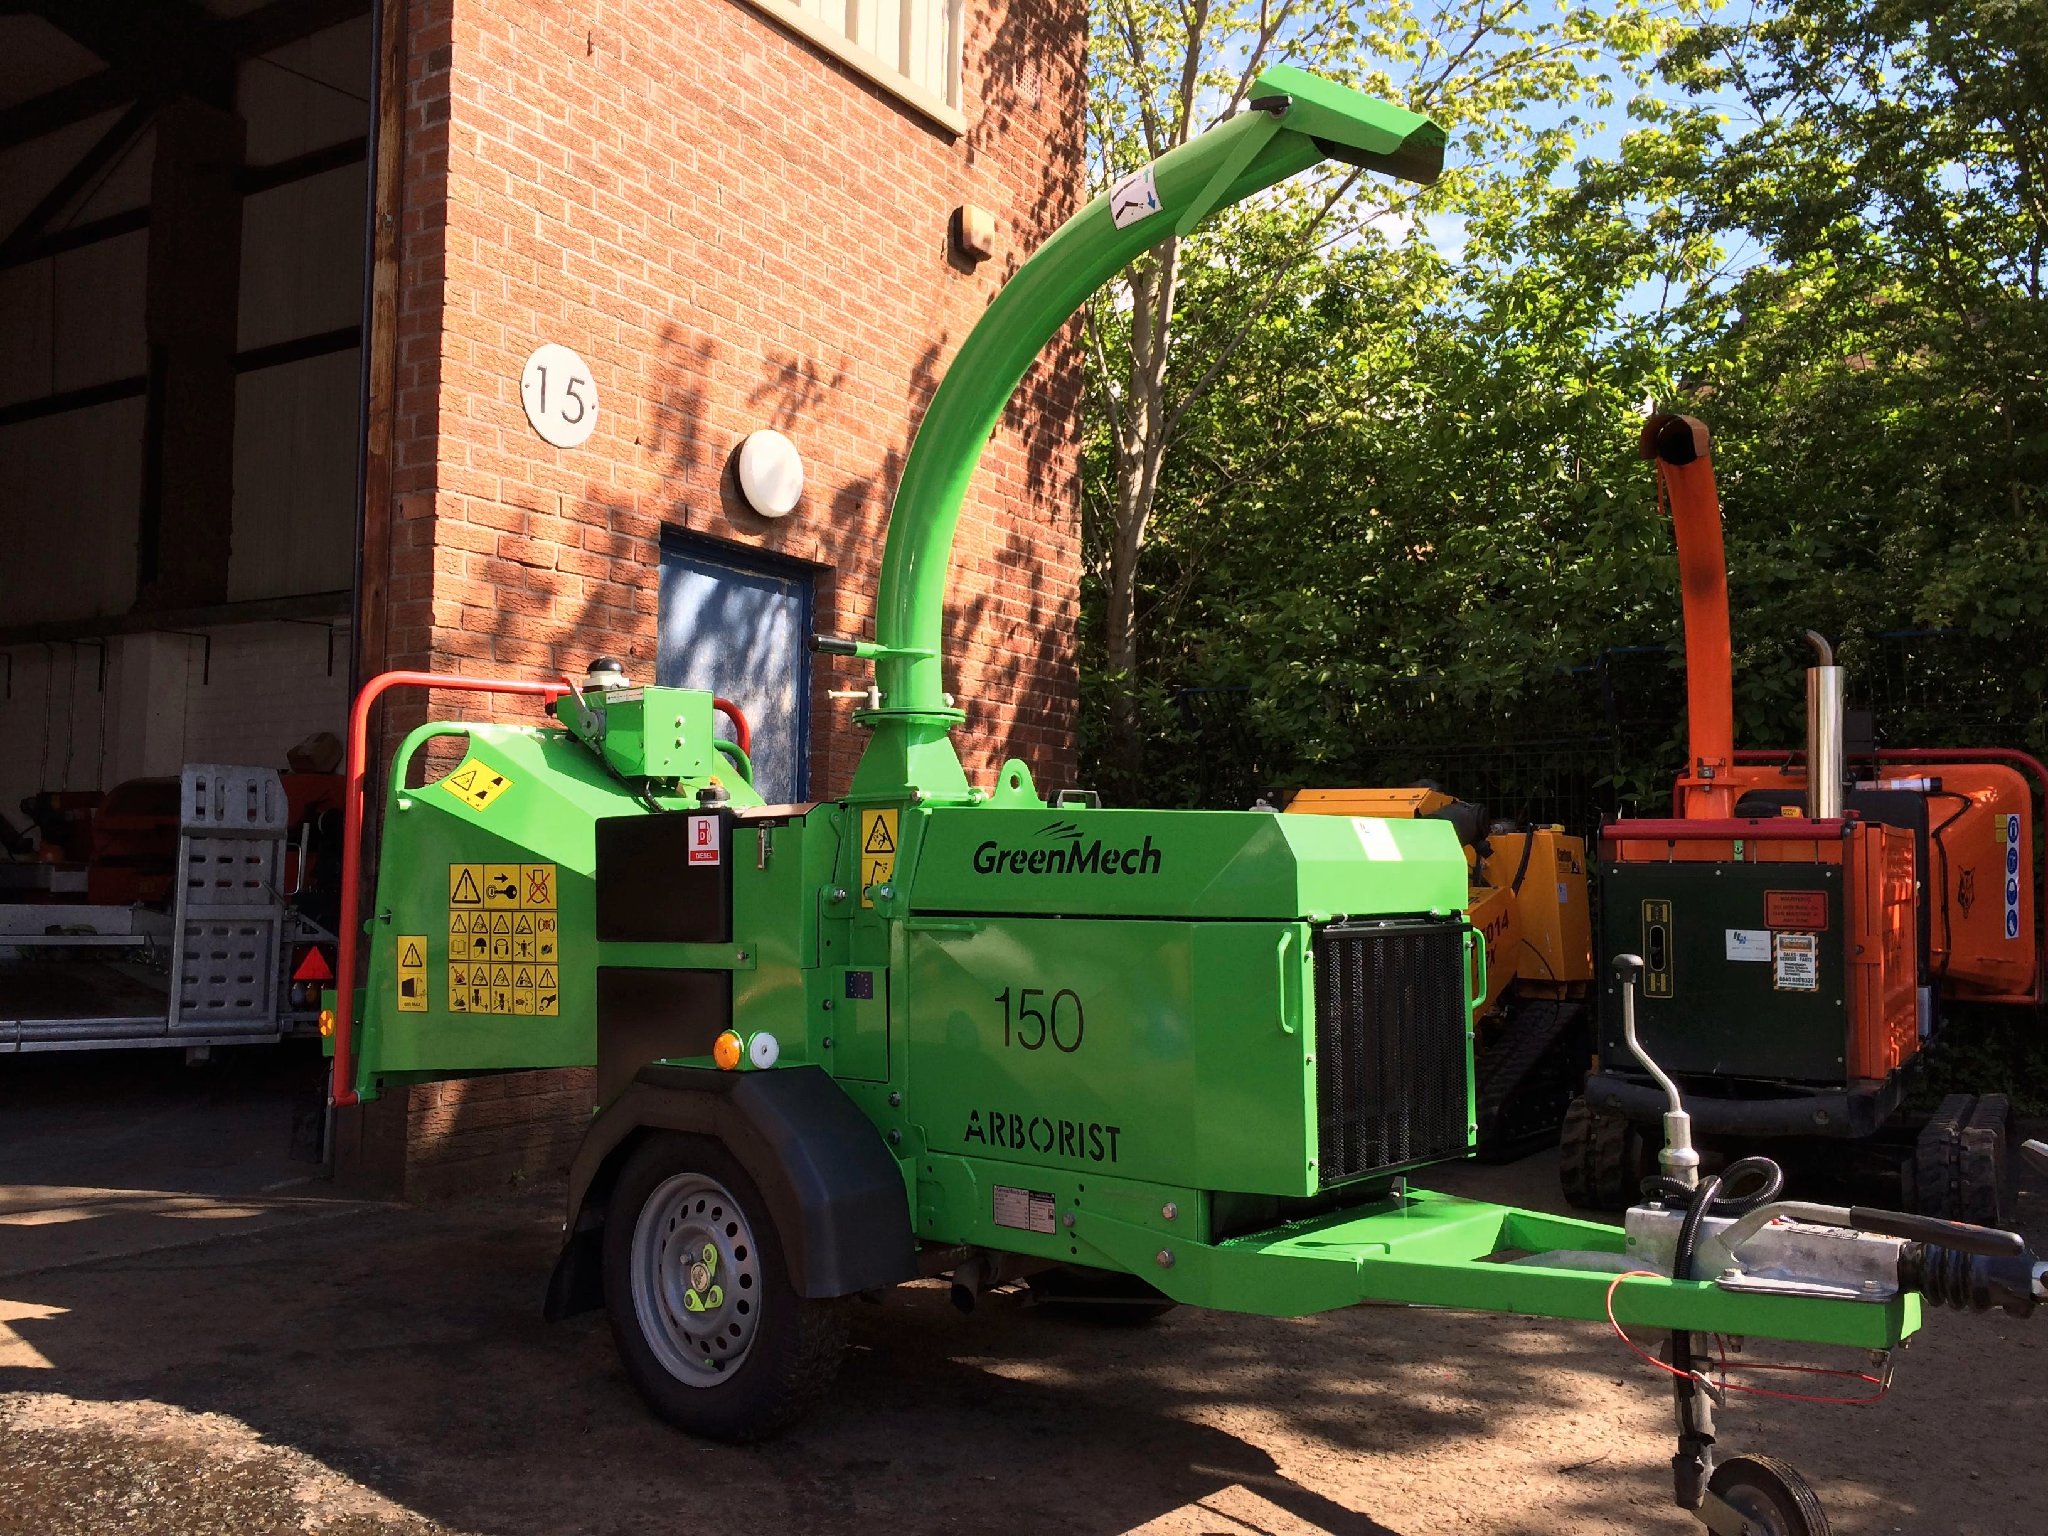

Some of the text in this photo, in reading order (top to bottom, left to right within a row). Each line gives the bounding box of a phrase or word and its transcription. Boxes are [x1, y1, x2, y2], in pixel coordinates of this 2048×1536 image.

[537, 365, 585, 424] 15
[973, 836, 1162, 875] GreenMech
[1482, 908, 1509, 944] 014
[995, 986, 1085, 1053] 150
[964, 1109, 1121, 1163] ARBORIST
